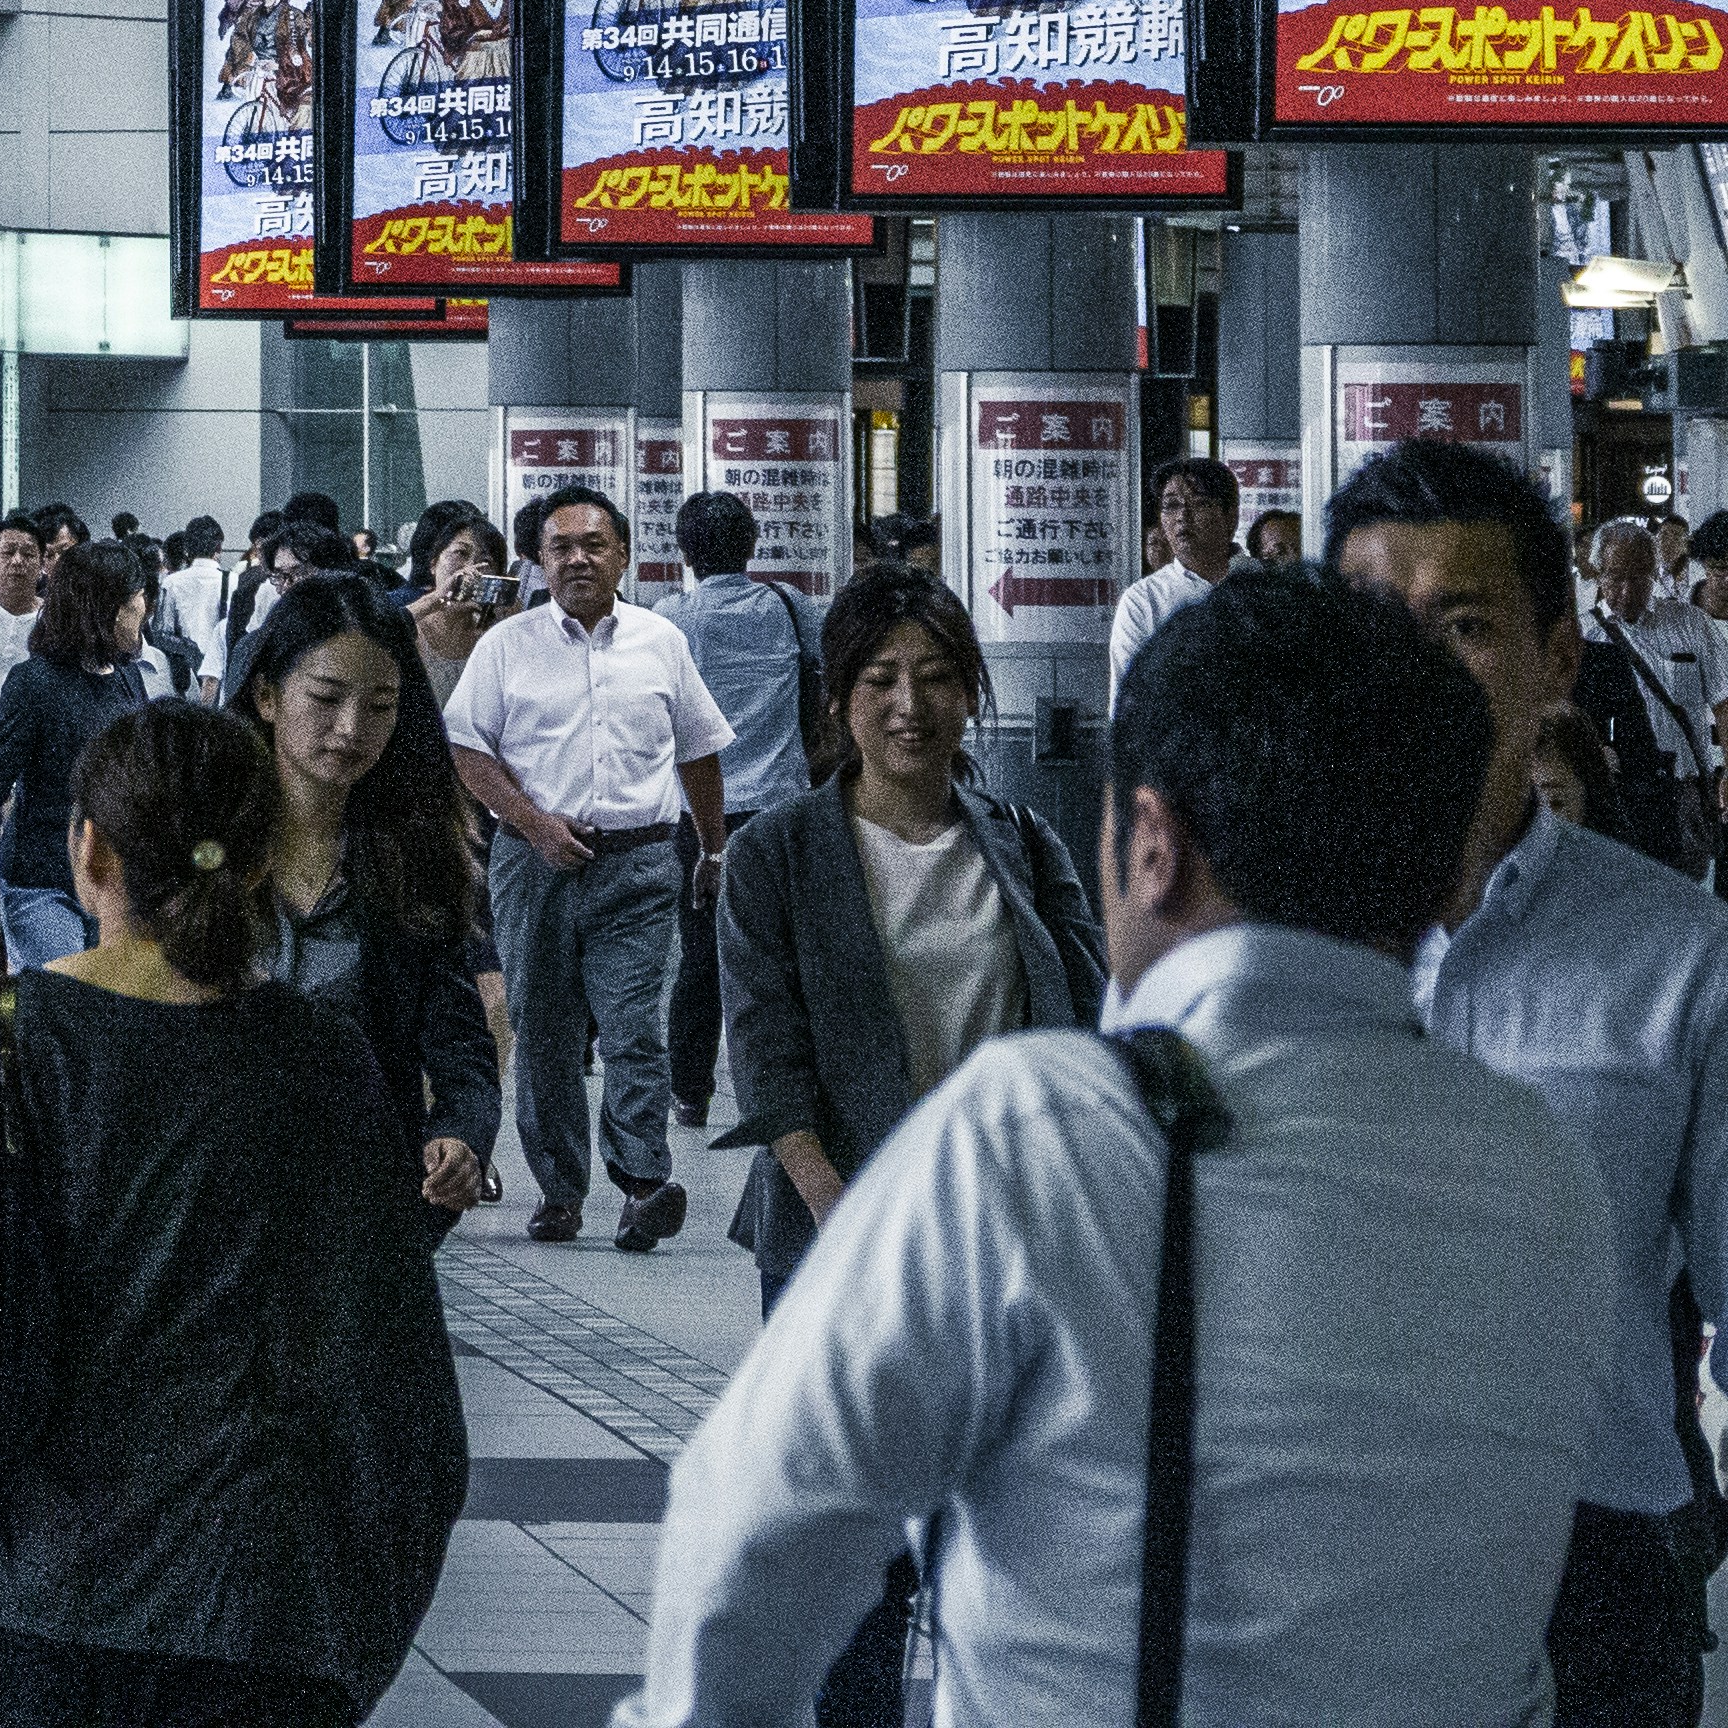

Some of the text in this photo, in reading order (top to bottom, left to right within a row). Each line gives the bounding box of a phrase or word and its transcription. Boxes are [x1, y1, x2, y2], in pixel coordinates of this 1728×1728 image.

[582, 7, 787, 51] 第34回 共同通信
[1296, 6, 1724, 72] パワースポットケイリン
[370, 95, 436, 118] 第34回
[215, 143, 273, 163] 第34回
[575, 164, 787, 209] パワースポットケ
[996, 413, 1114, 442] ご案内
[1363, 397, 1506, 432] ご案内
[522, 439, 613, 461] ご案内
[726, 430, 829, 453] ご案内
